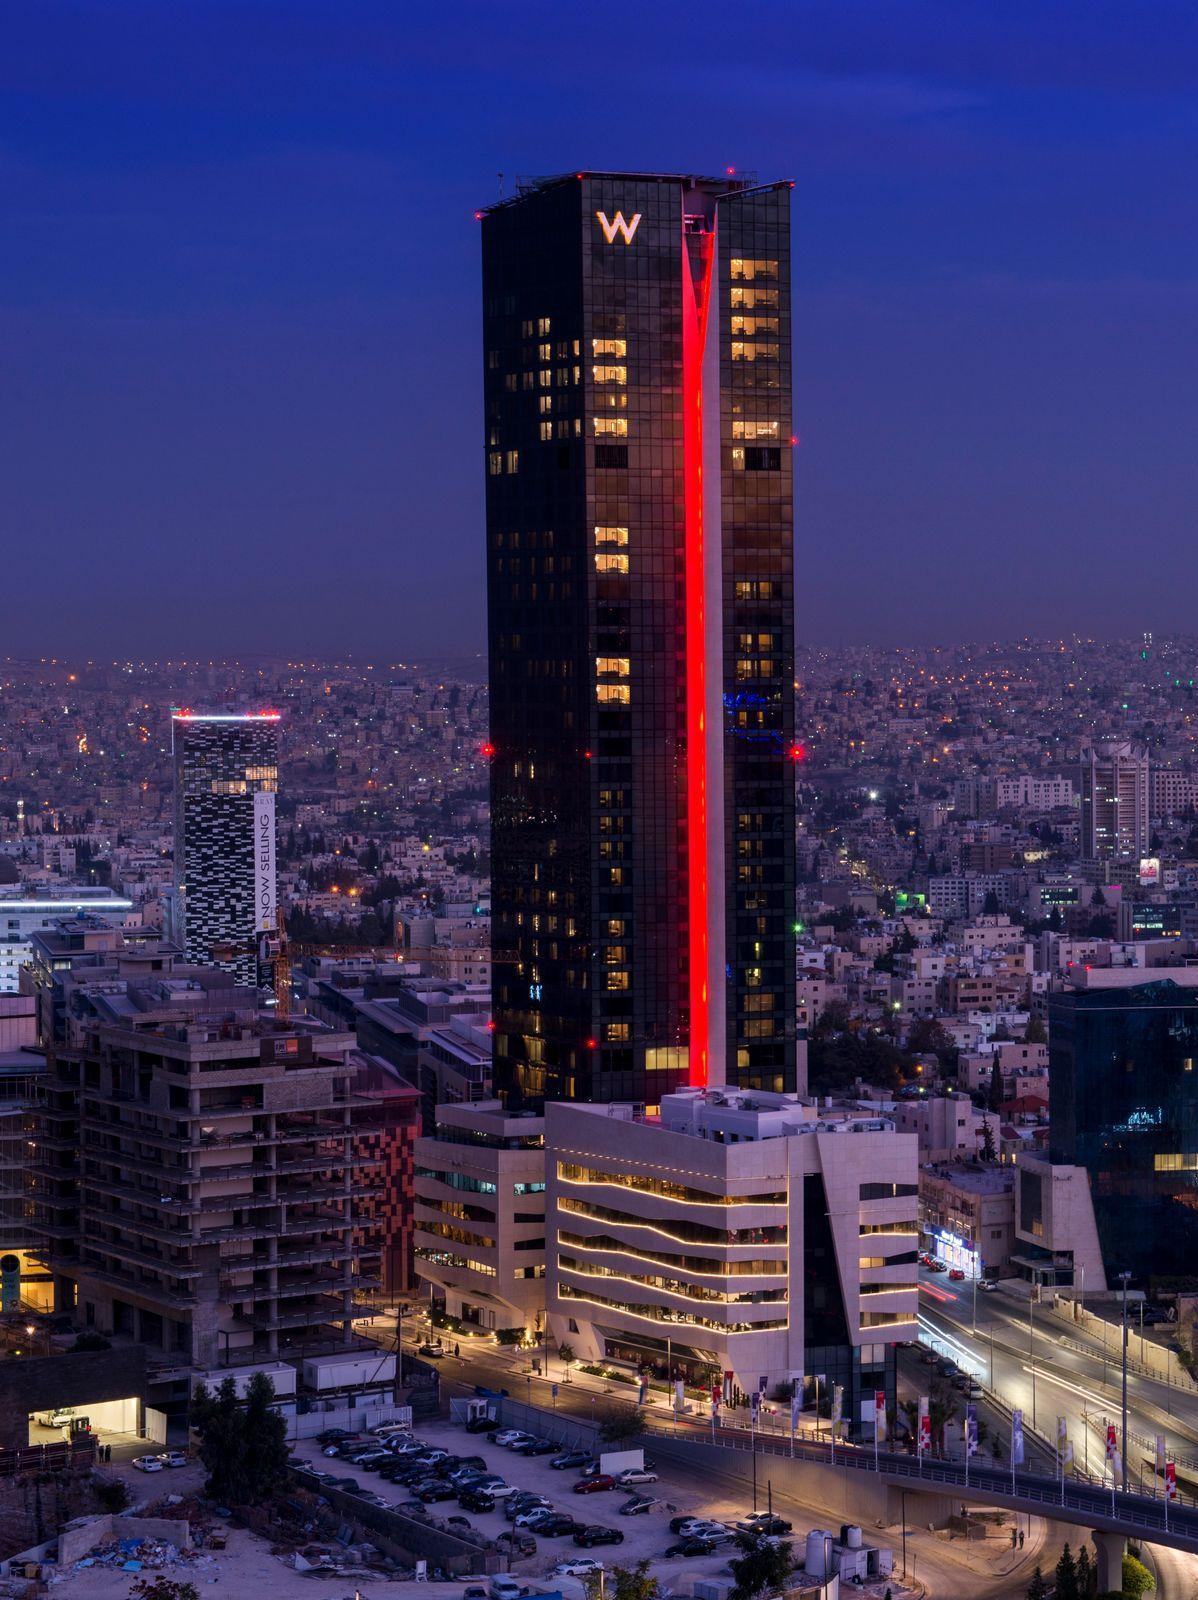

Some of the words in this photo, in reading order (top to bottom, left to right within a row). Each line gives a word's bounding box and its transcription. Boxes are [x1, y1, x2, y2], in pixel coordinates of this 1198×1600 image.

[596, 210, 642, 245] W
[260, 814, 270, 871] SELLING
[260, 876, 270, 918] NOW
